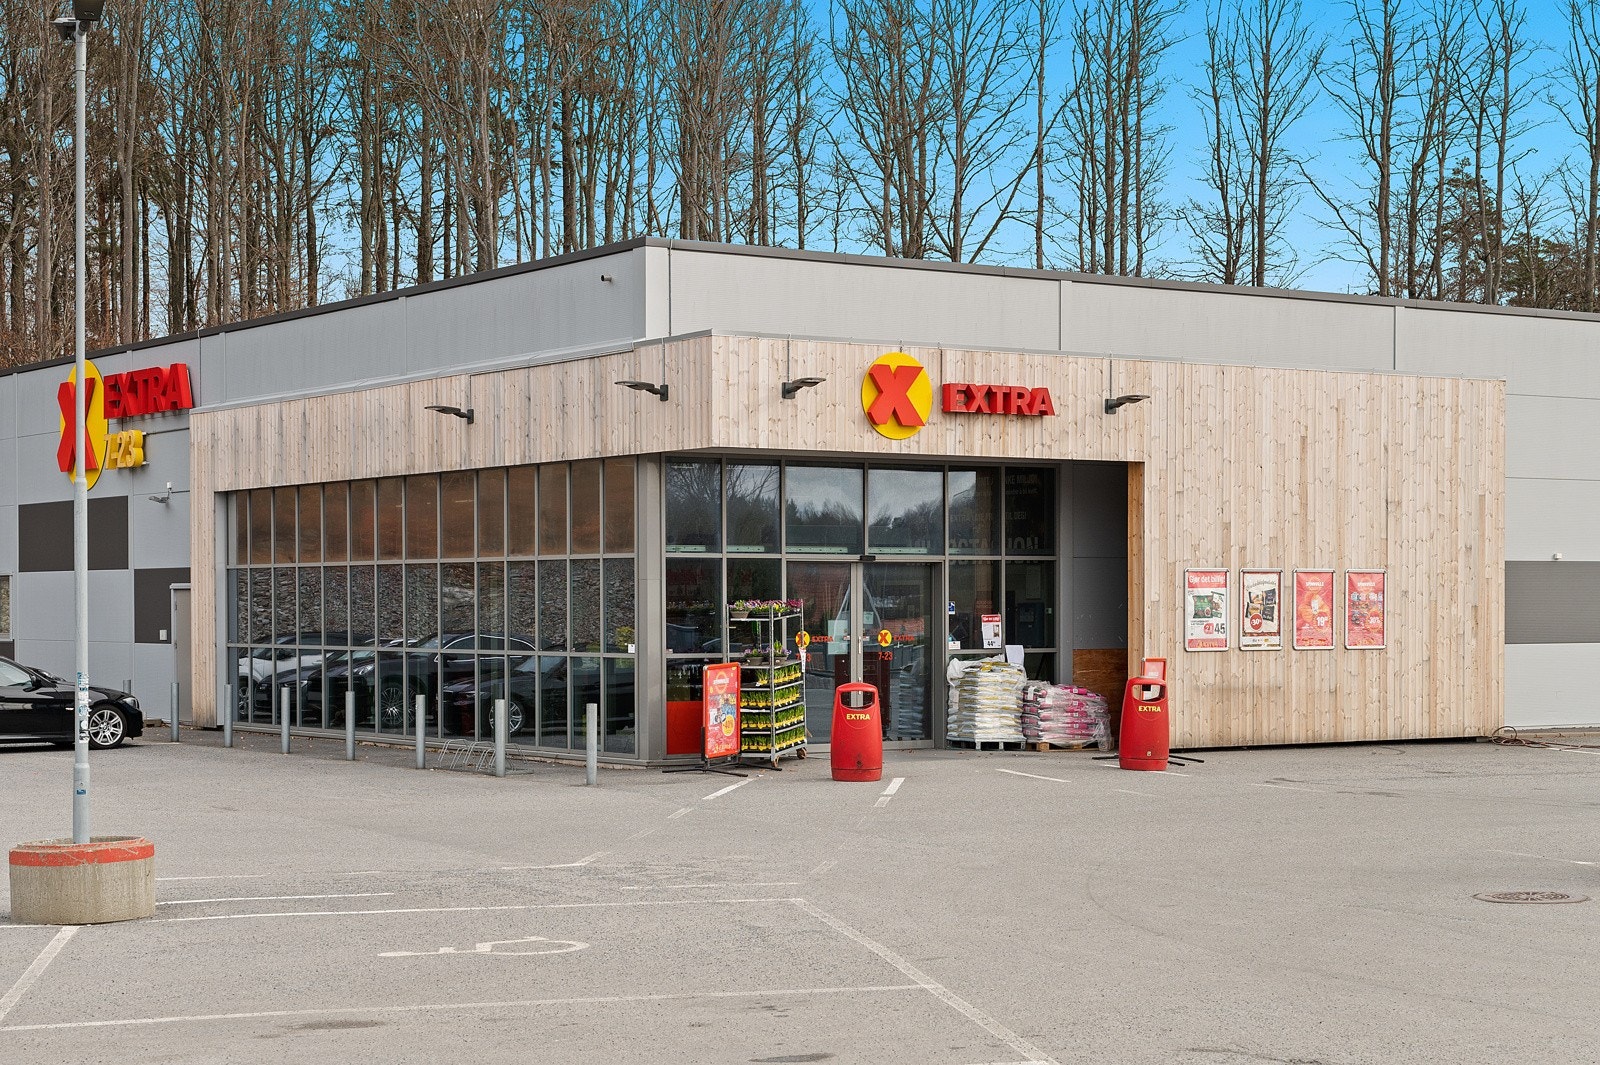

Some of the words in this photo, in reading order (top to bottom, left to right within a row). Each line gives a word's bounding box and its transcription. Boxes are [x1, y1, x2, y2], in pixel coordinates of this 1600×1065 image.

[104, 363, 193, 419] EXTRA
[867, 363, 926, 427] X
[942, 382, 1056, 417] EXTRA
[104, 429, 144, 470] 7-23
[1214, 622, 1226, 635] 45
[878, 651, 893, 661] 7-23
